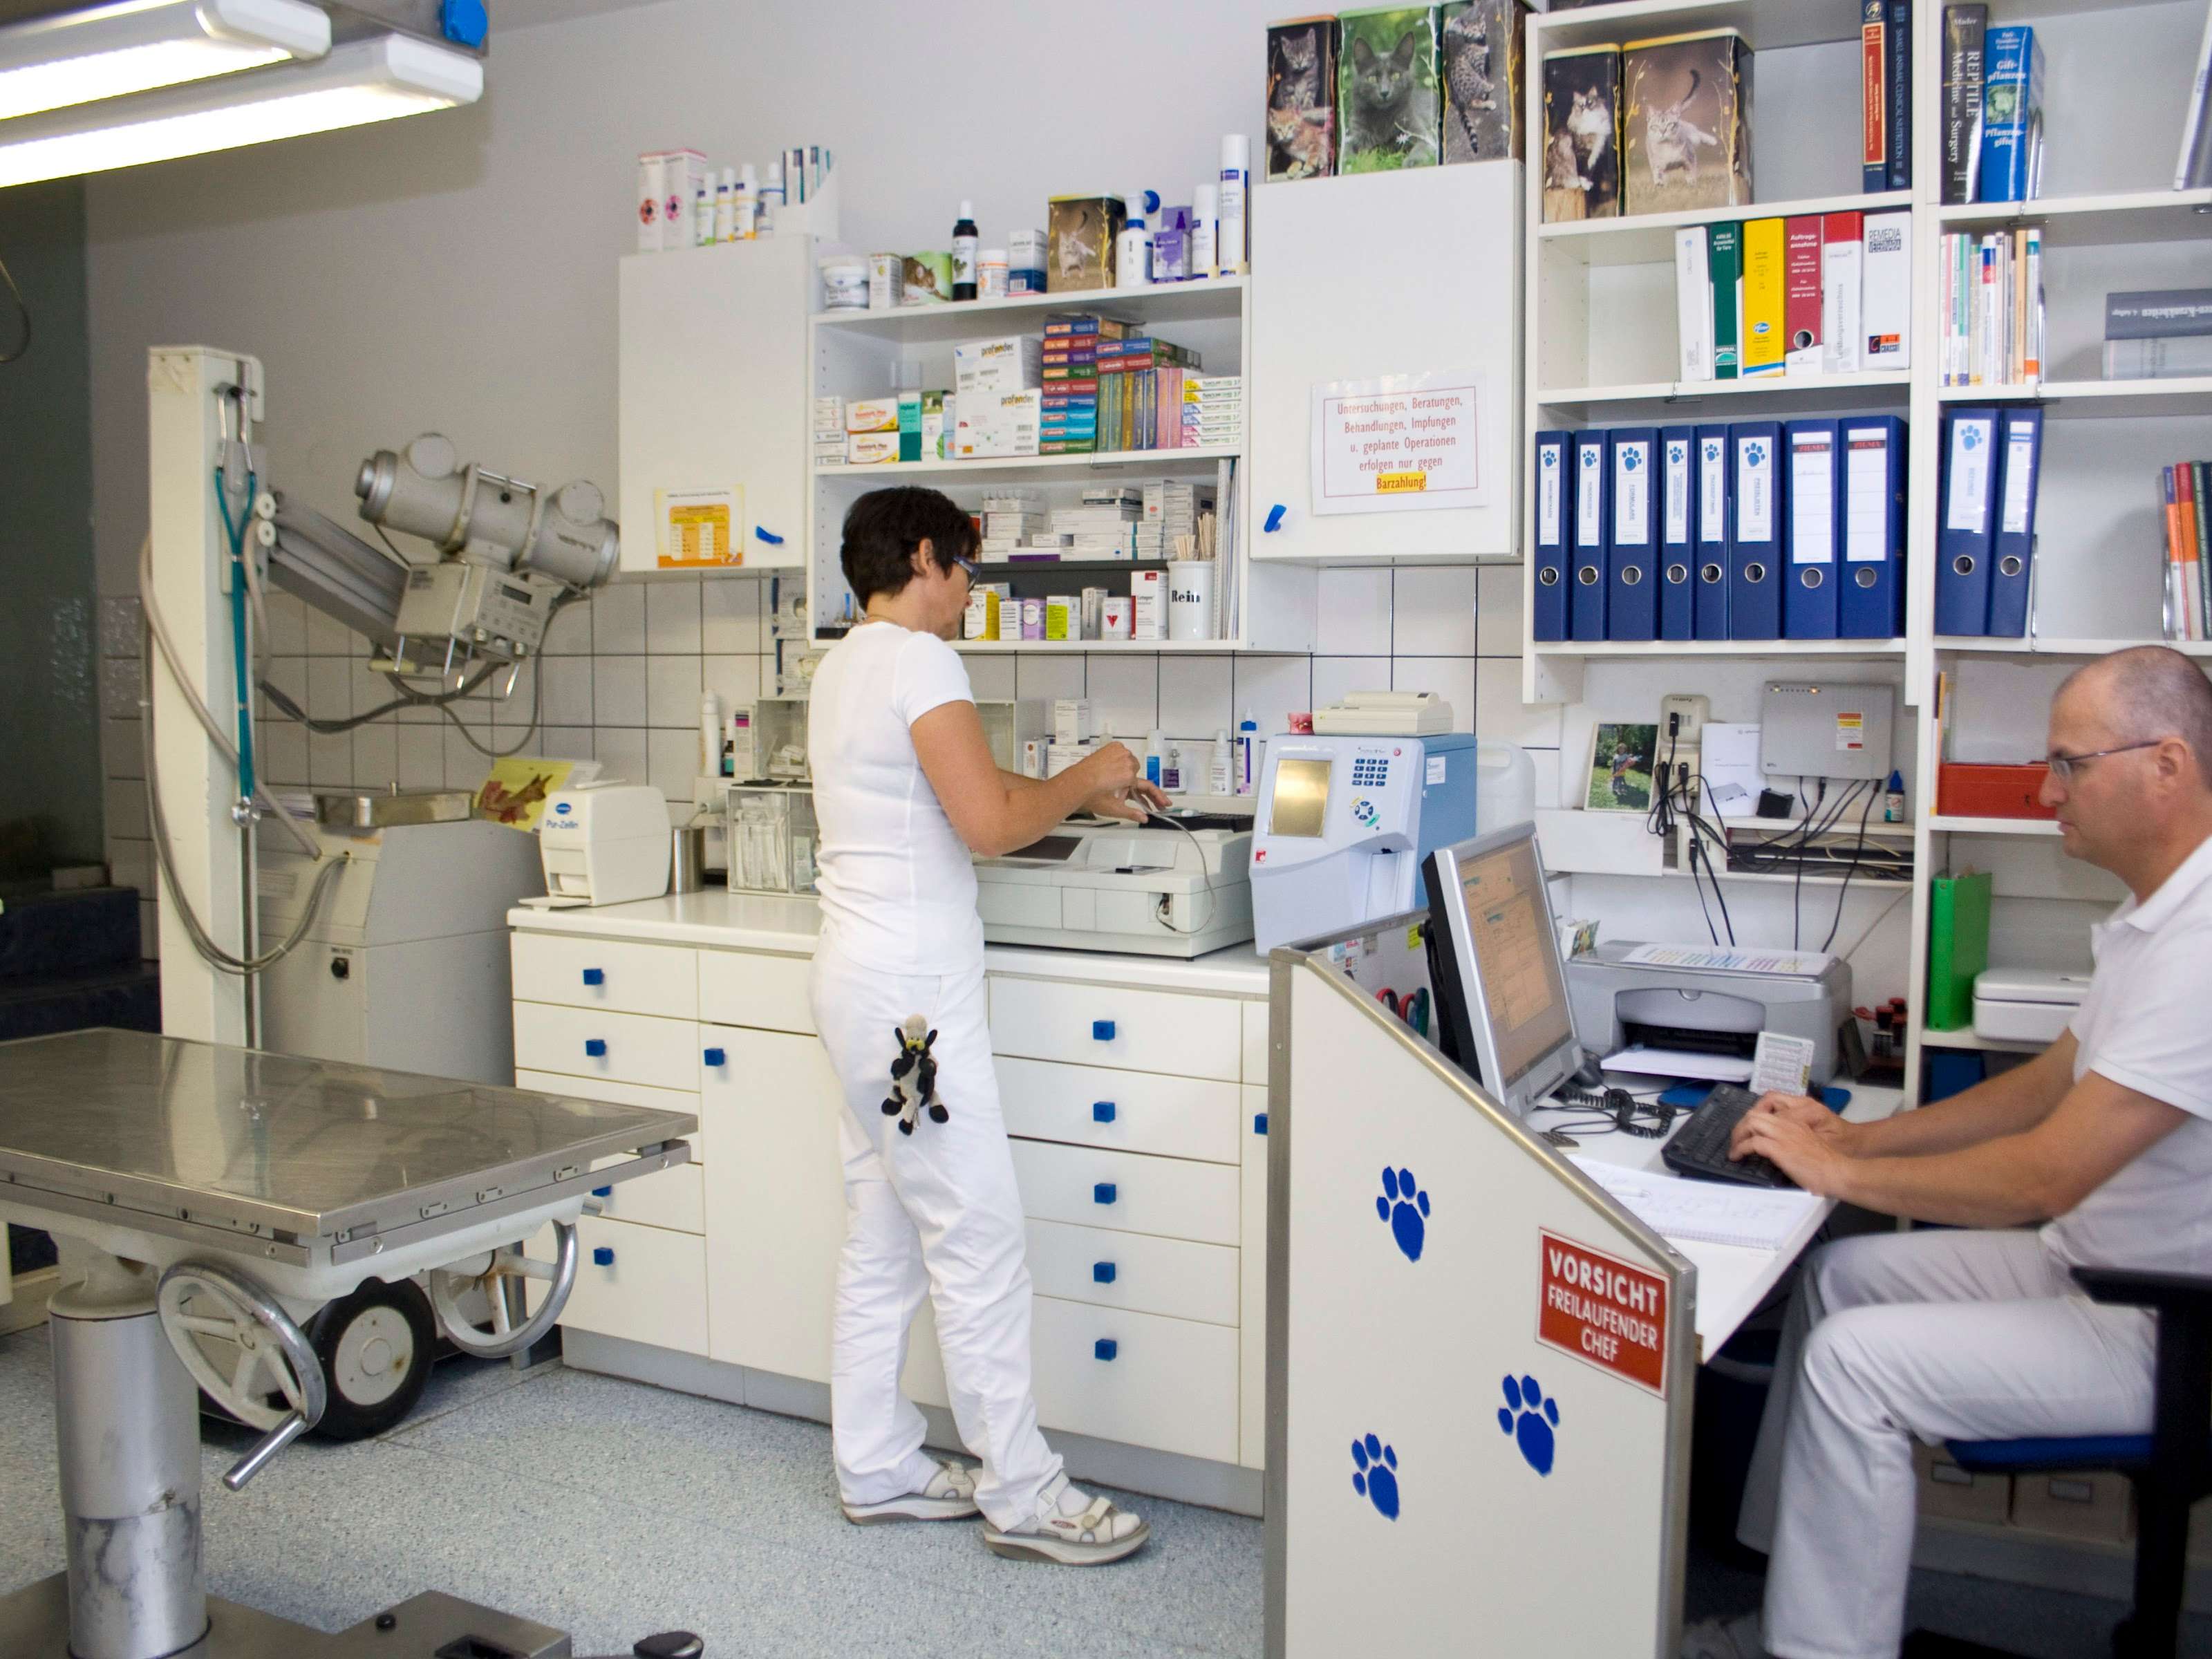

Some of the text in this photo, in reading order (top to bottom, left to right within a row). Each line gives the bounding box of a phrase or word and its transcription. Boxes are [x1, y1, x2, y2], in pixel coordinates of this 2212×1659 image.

[1996, 61, 2018, 71] Gift-
[1951, 52, 1965, 104] Medicine
[1966, 50, 1981, 118] REPTILE
[1948, 120, 1962, 163] Surgery
[981, 341, 1014, 357] profender
[1000, 393, 1035, 407] profender
[1338, 395, 1463, 415] Untersuchungen, Beratungen,
[1344, 415, 1456, 434] Behandlungen, Impfungen
[1350, 435, 1456, 455] u. geplante Operationen
[1359, 456, 1443, 474] erfolgen nur gegen
[1376, 475, 1427, 491] Barzahlung!
[1171, 590, 1201, 603] Rein
[1548, 1247, 1658, 1317] VORSICHT
[1548, 1286, 1658, 1351] FREILAUFENDER
[1581, 1329, 1620, 1362] CHEF
